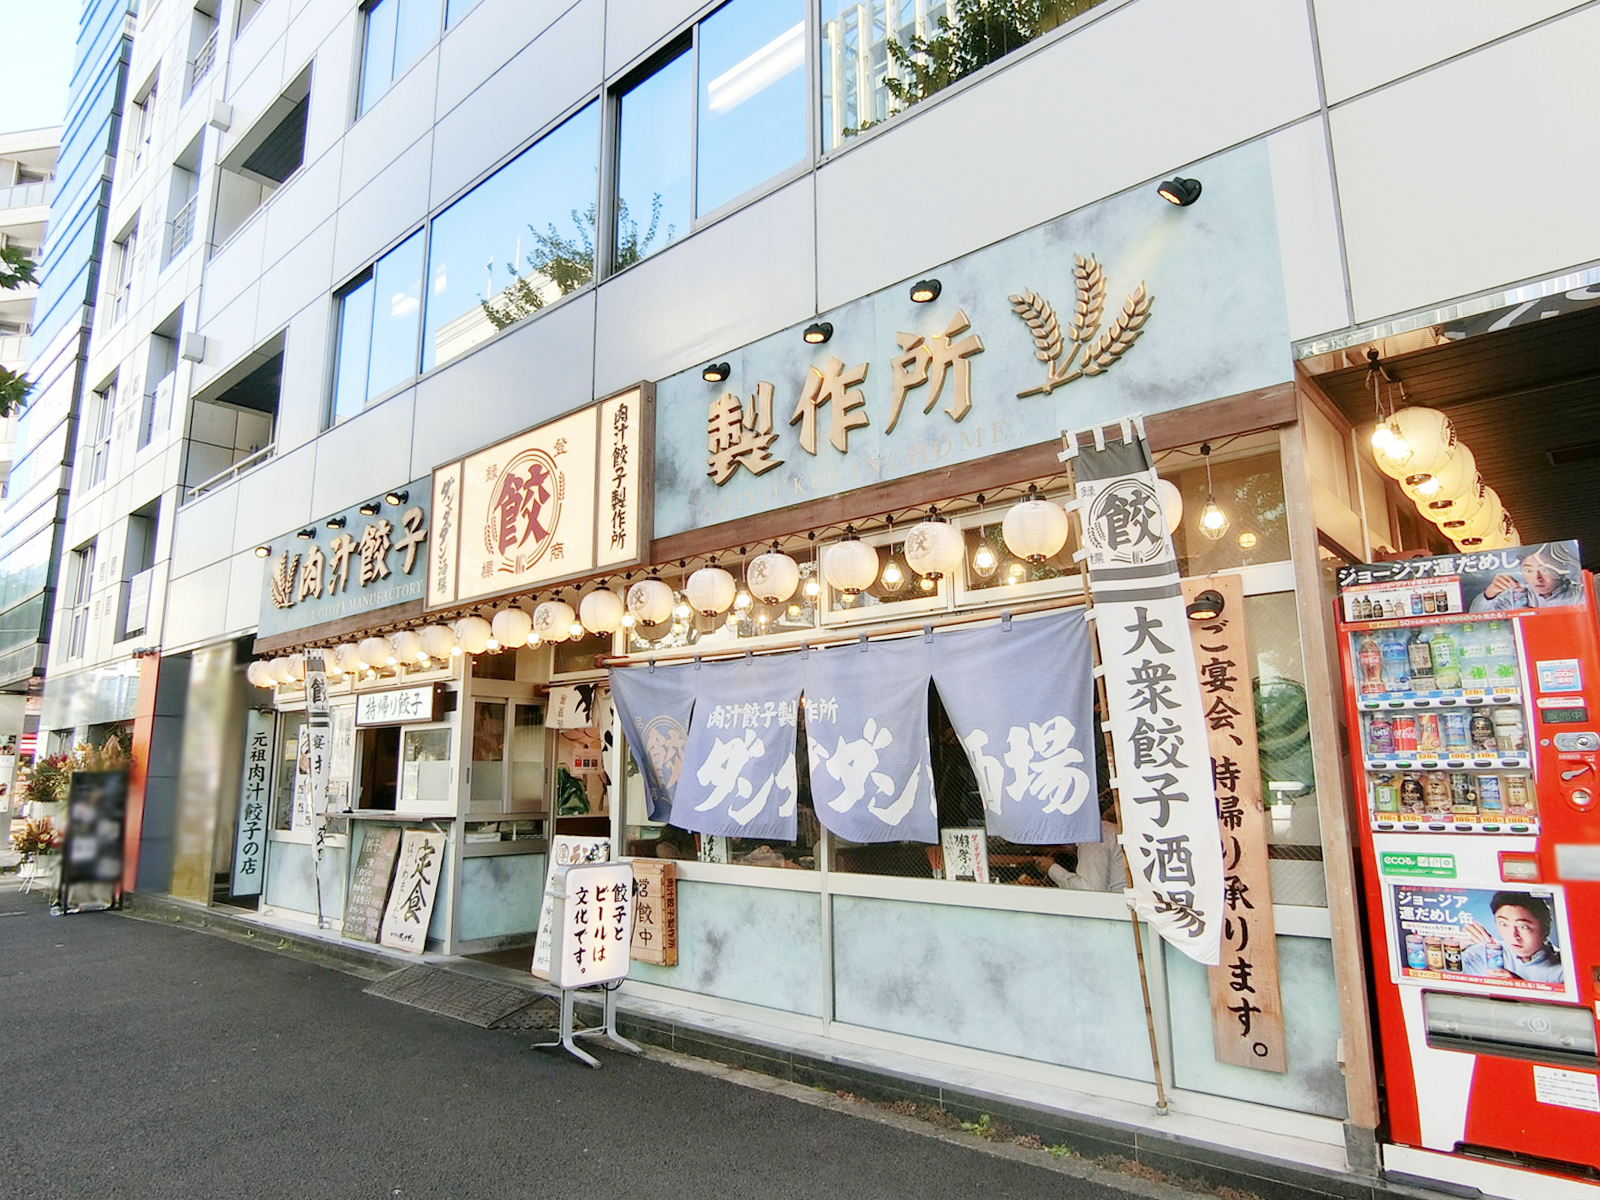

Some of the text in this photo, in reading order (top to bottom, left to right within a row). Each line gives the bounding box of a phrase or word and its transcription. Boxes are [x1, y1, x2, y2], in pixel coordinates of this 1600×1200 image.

[706, 308, 986, 487] 製作所
[493, 463, 551, 556] 餃
[610, 402, 629, 551] 肉汁餃子製作所
[297, 506, 428, 603] 肉汁餃子
[1096, 489, 1162, 551] 餃
[349, 579, 424, 609] MANUFACTORY
[1338, 551, 1520, 587] ジョージア運だめし
[365, 691, 423, 720] 持帰り餃子
[706, 695, 840, 730] 肉汁餃子製作所
[239, 731, 268, 876] 元祖肉汁餃子の店
[1121, 606, 1207, 938] 大衆餃子酒場
[400, 839, 436, 925] 定食
[612, 883, 628, 941] 餃子と
[637, 877, 654, 947] 営餃中
[1397, 891, 1469, 909] ジョージア
[1398, 905, 1474, 926] 運だめし缶
[572, 886, 590, 975] 文化です。
[592, 884, 609, 962] ビールは
